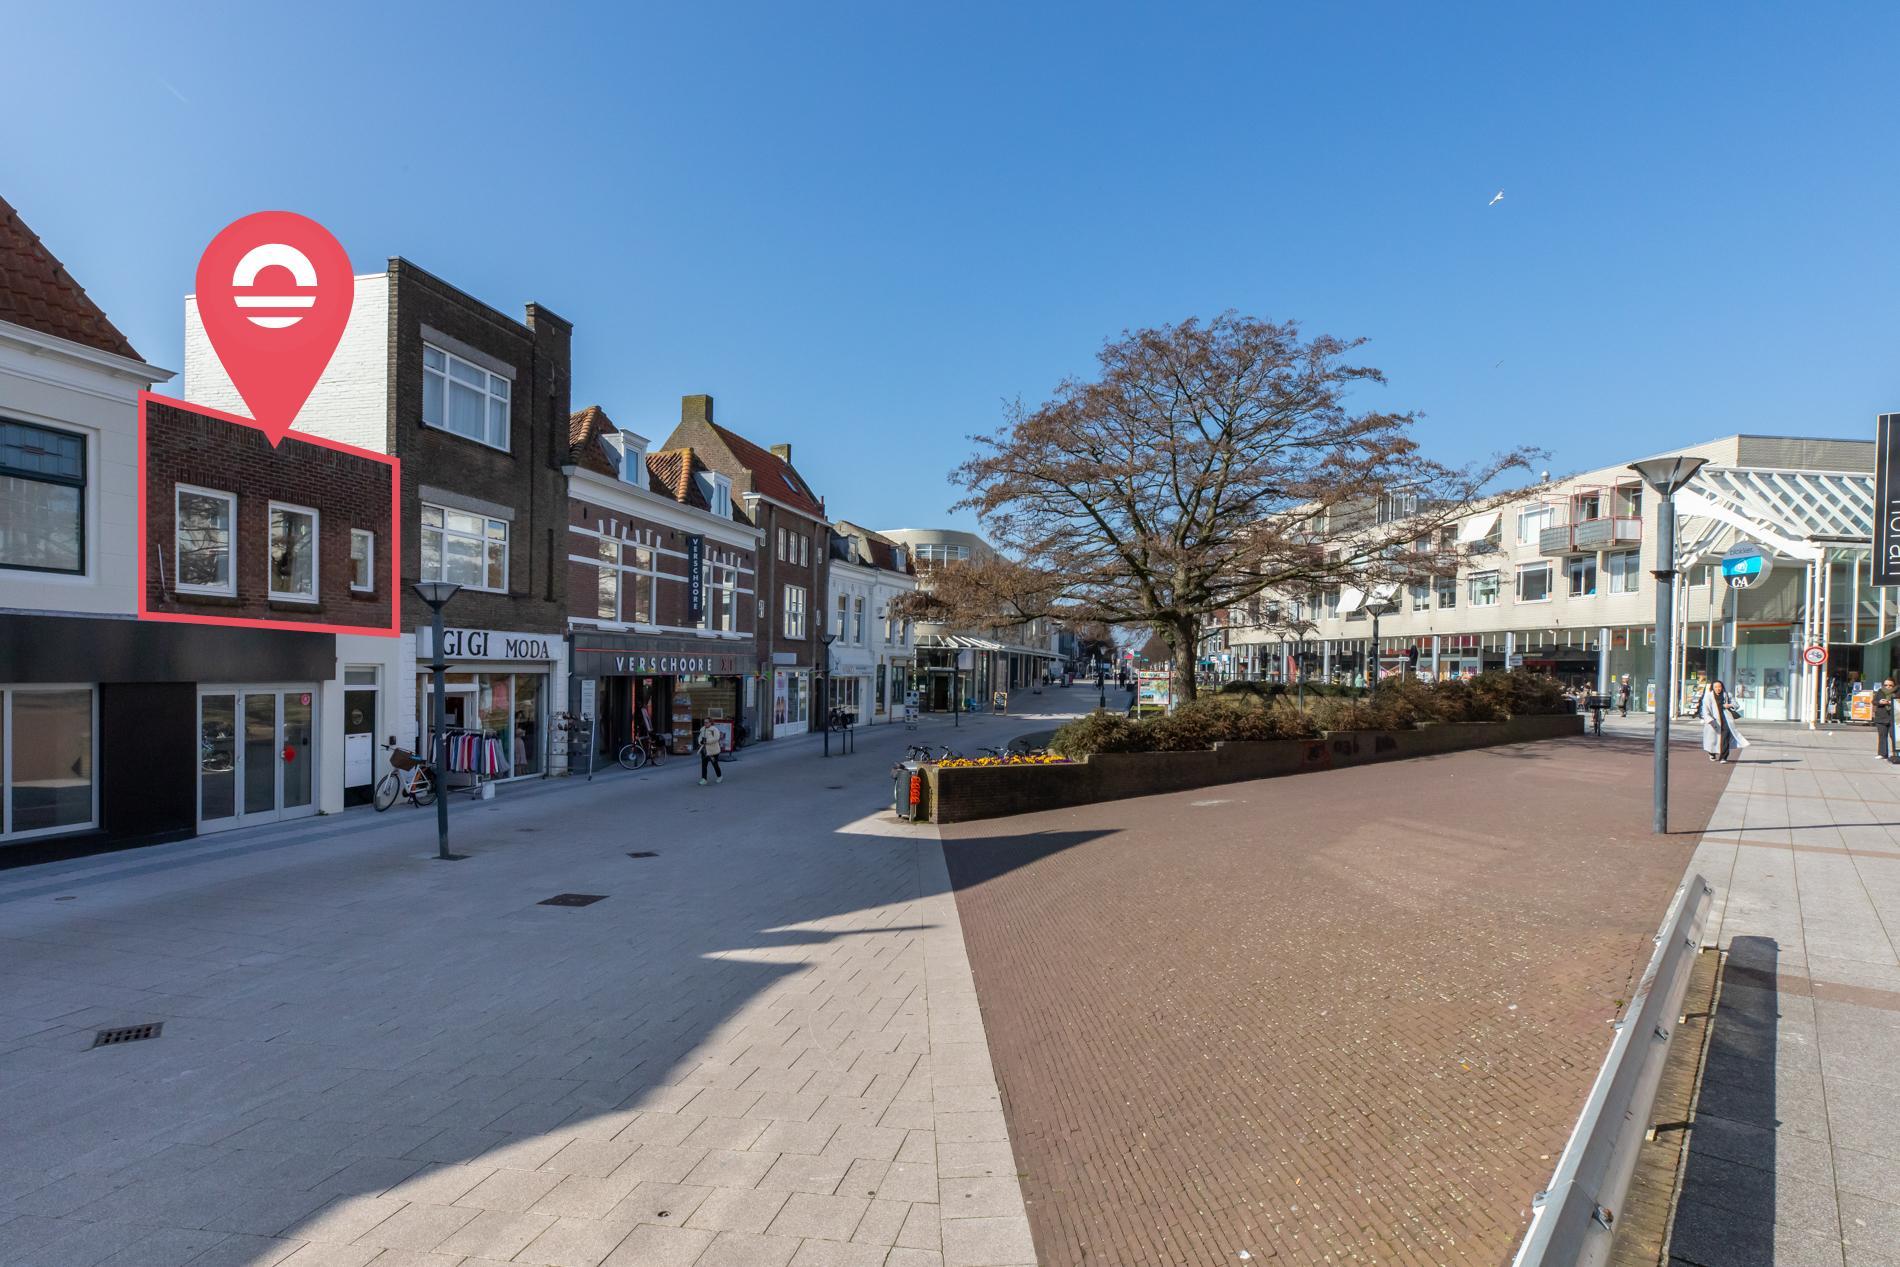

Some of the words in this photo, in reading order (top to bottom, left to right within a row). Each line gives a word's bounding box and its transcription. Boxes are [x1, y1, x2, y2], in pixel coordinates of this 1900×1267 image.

[692, 538, 700, 610] VERSCHOORE
[505, 638, 550, 659] MODA
[616, 656, 712, 673] VERSCHOORE
